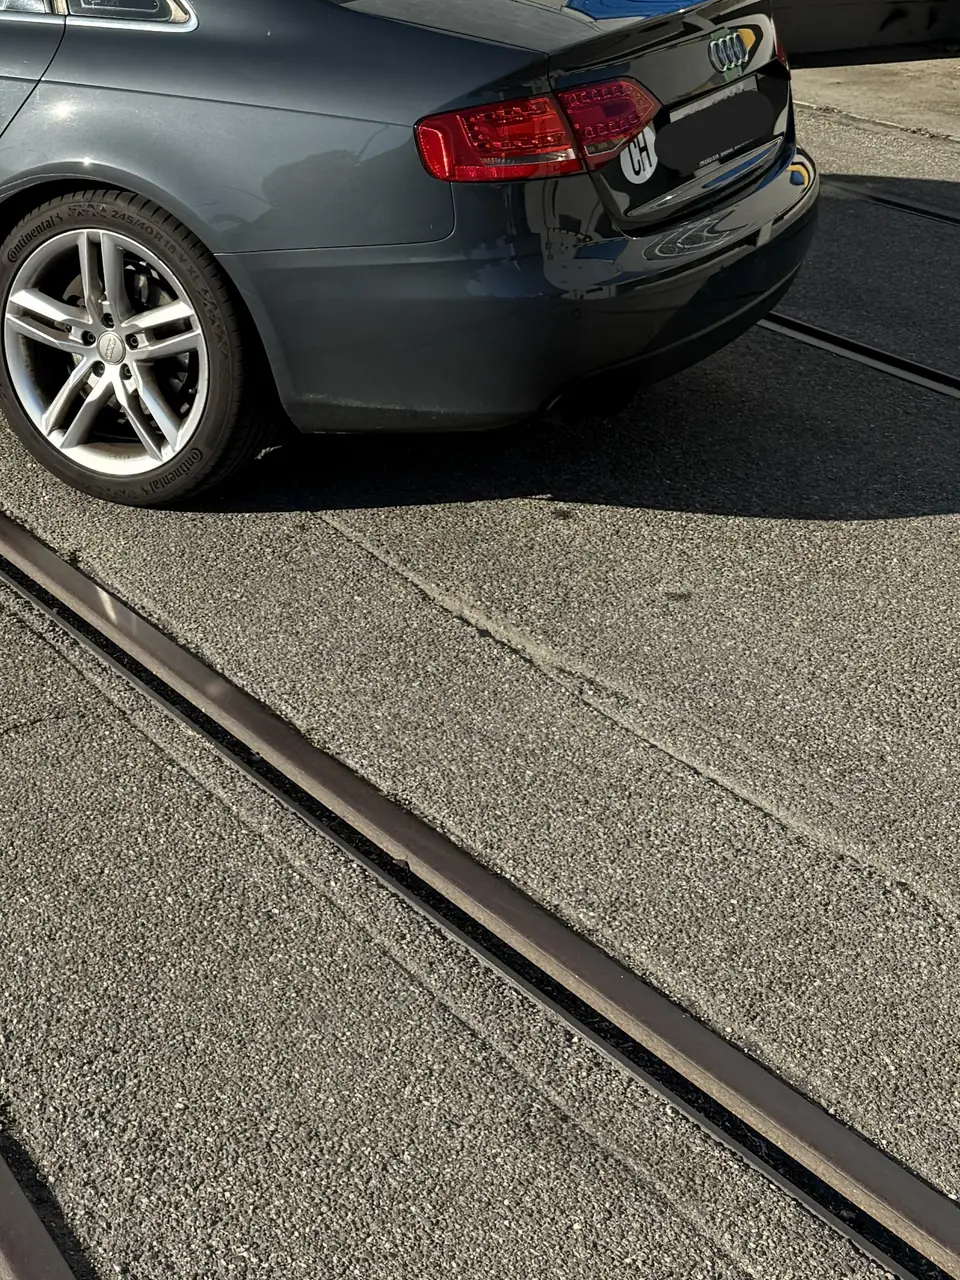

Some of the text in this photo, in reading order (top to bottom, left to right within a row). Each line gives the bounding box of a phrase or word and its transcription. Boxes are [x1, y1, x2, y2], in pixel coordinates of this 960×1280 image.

[628, 131, 652, 176] CH
[7, 215, 57, 262] Continental
[111, 210, 154, 235] 245/40
[148, 447, 204, 494] Continental
